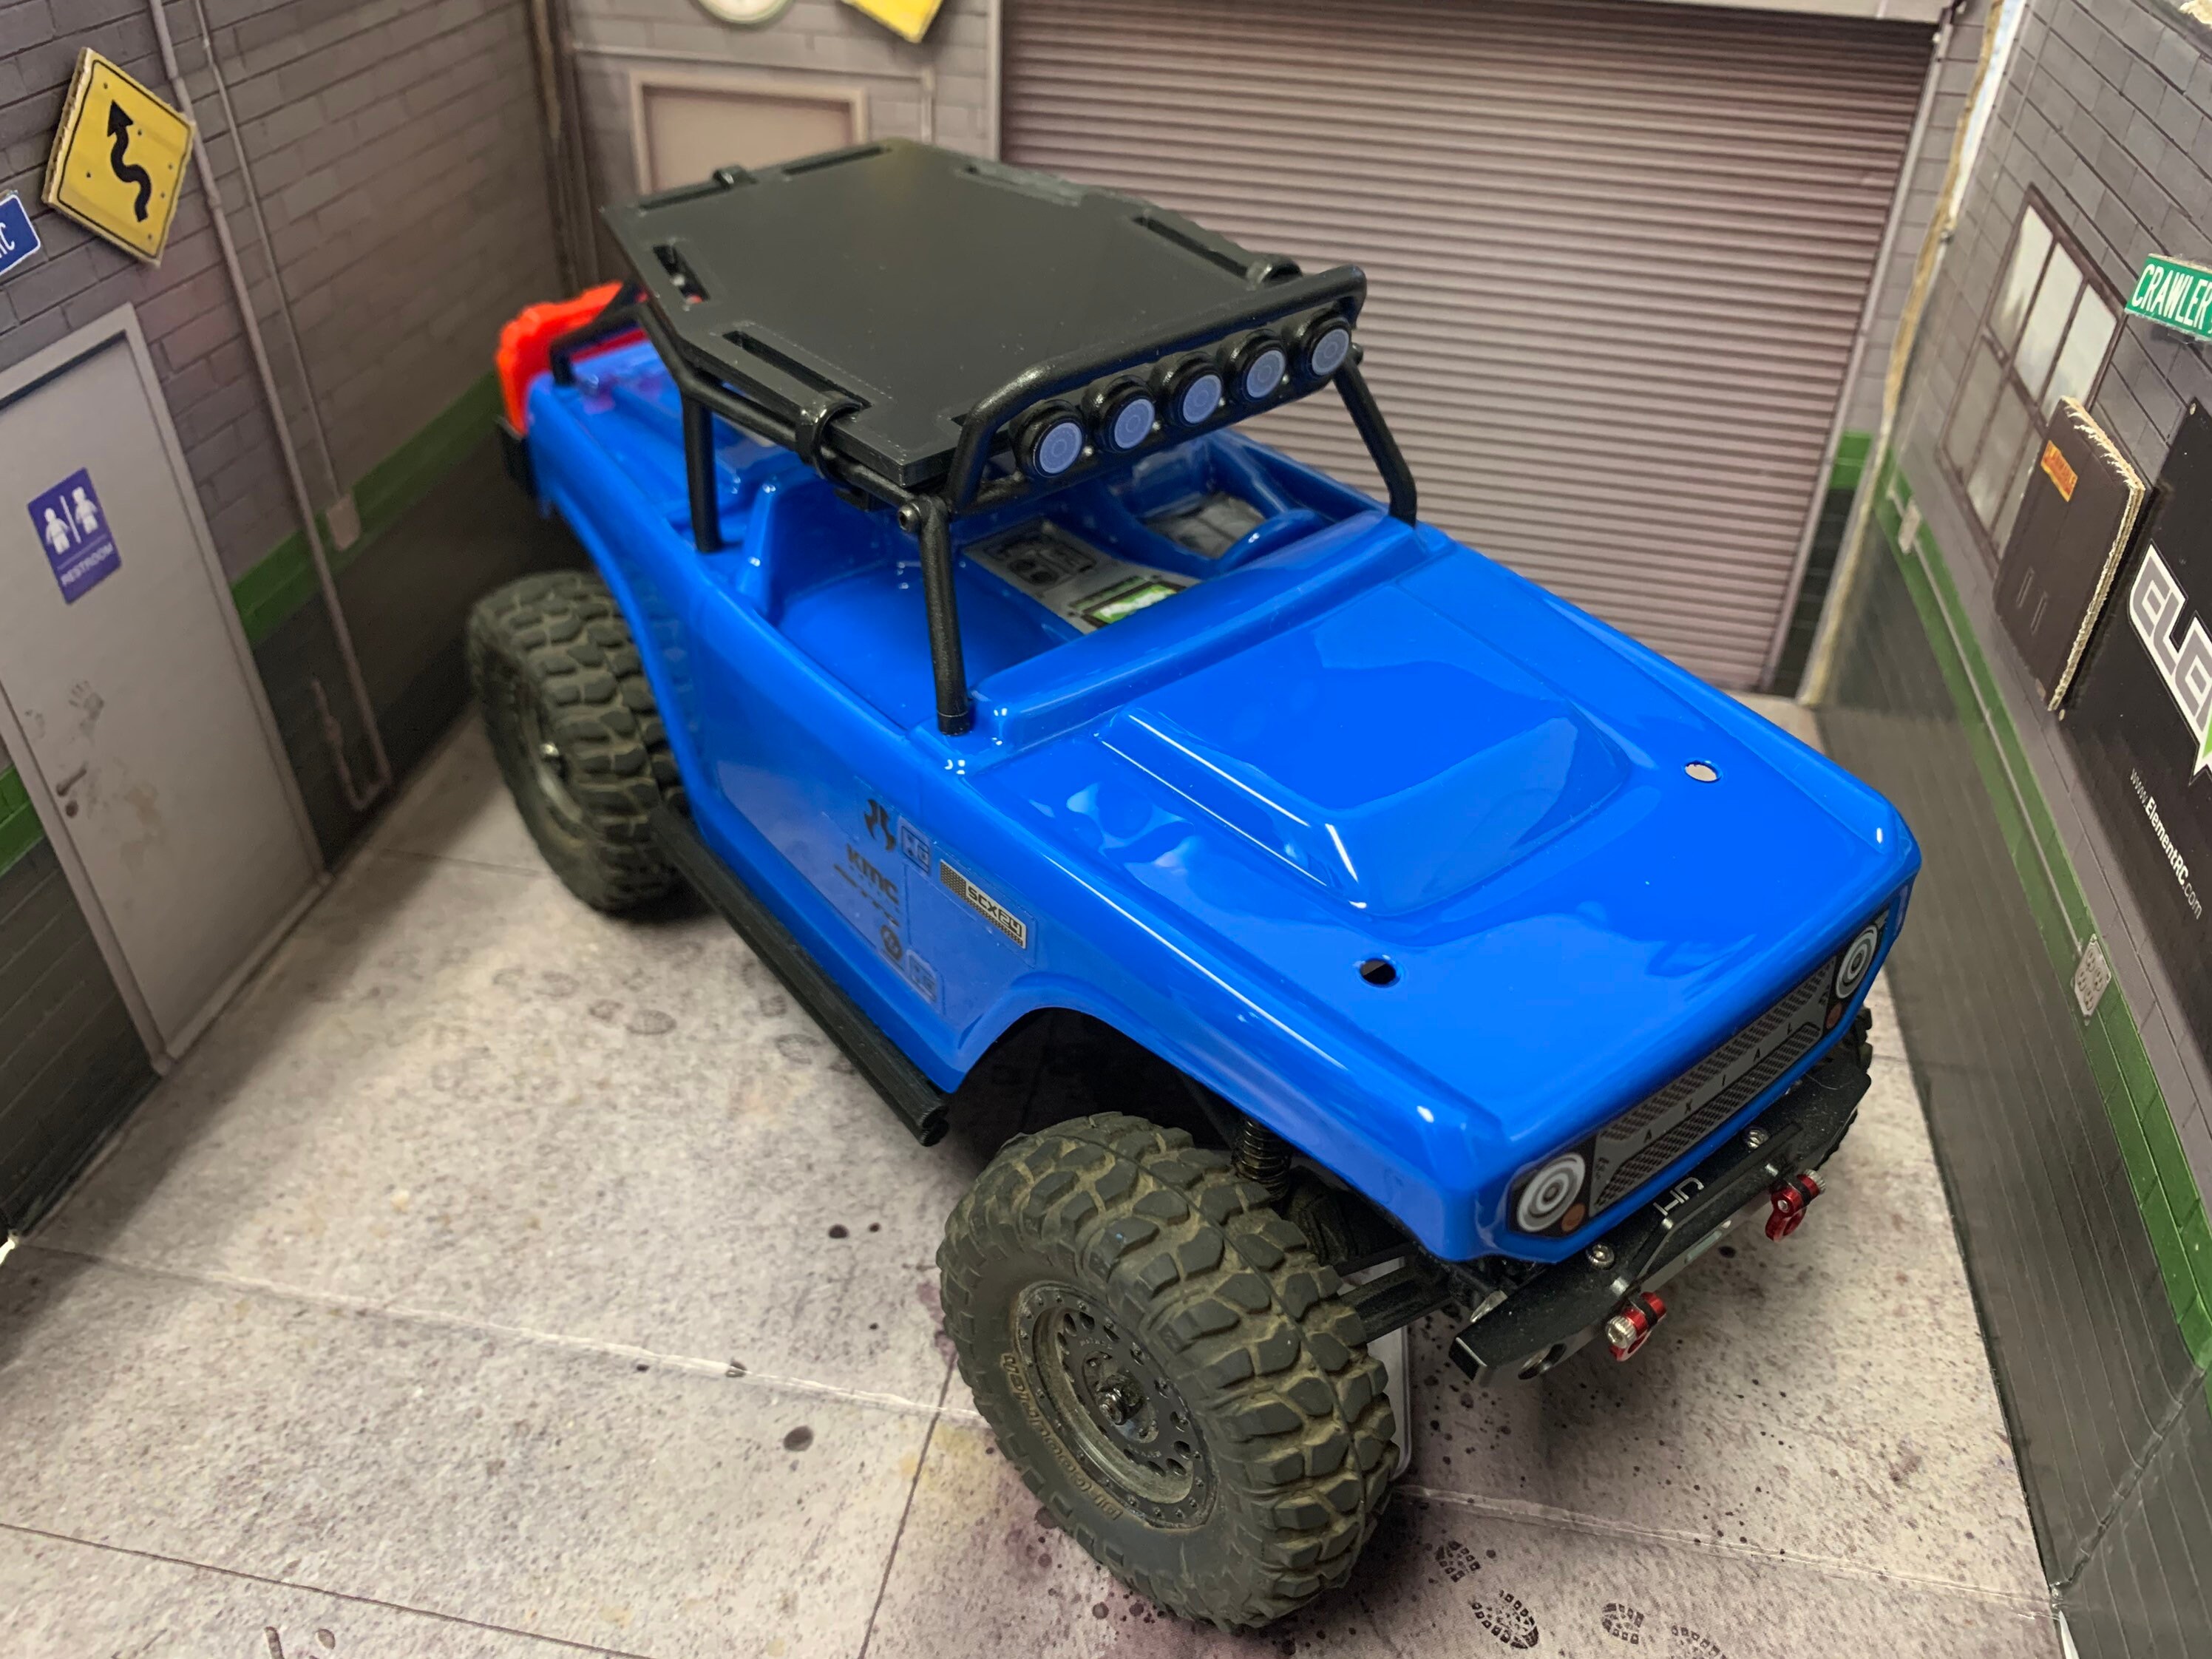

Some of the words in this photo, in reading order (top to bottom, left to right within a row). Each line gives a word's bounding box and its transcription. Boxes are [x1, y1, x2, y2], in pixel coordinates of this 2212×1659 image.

[2131, 263, 2212, 330] CRAWLER
[60, 542, 114, 587] RESTROOM
[2130, 767, 2202, 920] www.ElementRC.com
[968, 886, 1022, 938] SCX24
